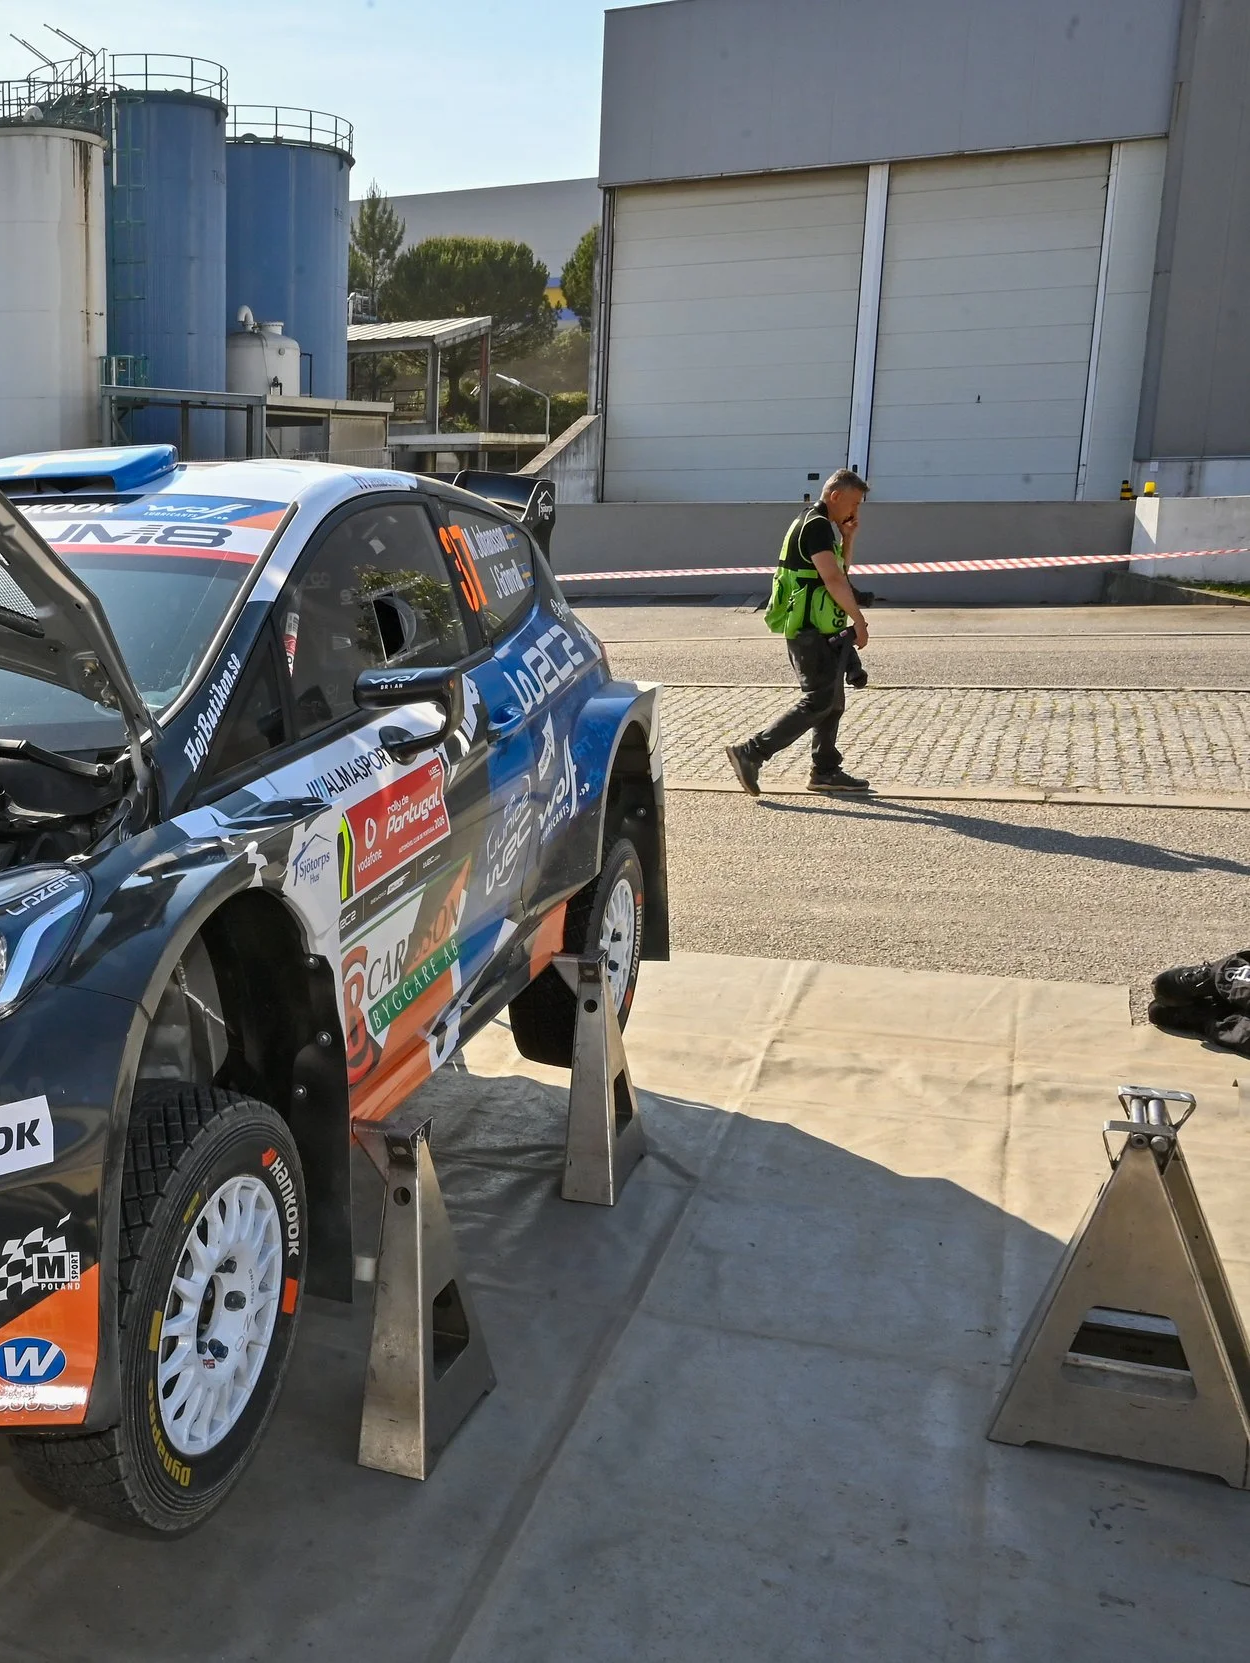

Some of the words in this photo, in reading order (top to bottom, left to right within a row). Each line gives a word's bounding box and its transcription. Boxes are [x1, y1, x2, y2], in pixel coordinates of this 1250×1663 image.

[143, 511, 199, 519] LUBRICANTS
[439, 525, 488, 612] 37
[299, 851, 331, 881] Sjötorps
[357, 849, 383, 873] vodafone
[372, 957, 439, 1031] BYGGARE
[443, 938, 459, 964] AB
[36, 1255, 66, 1280] M
[70, 1253, 79, 1281] SPORT
[40, 1282, 81, 1292] POLAND
[3, 1342, 62, 1377] W
